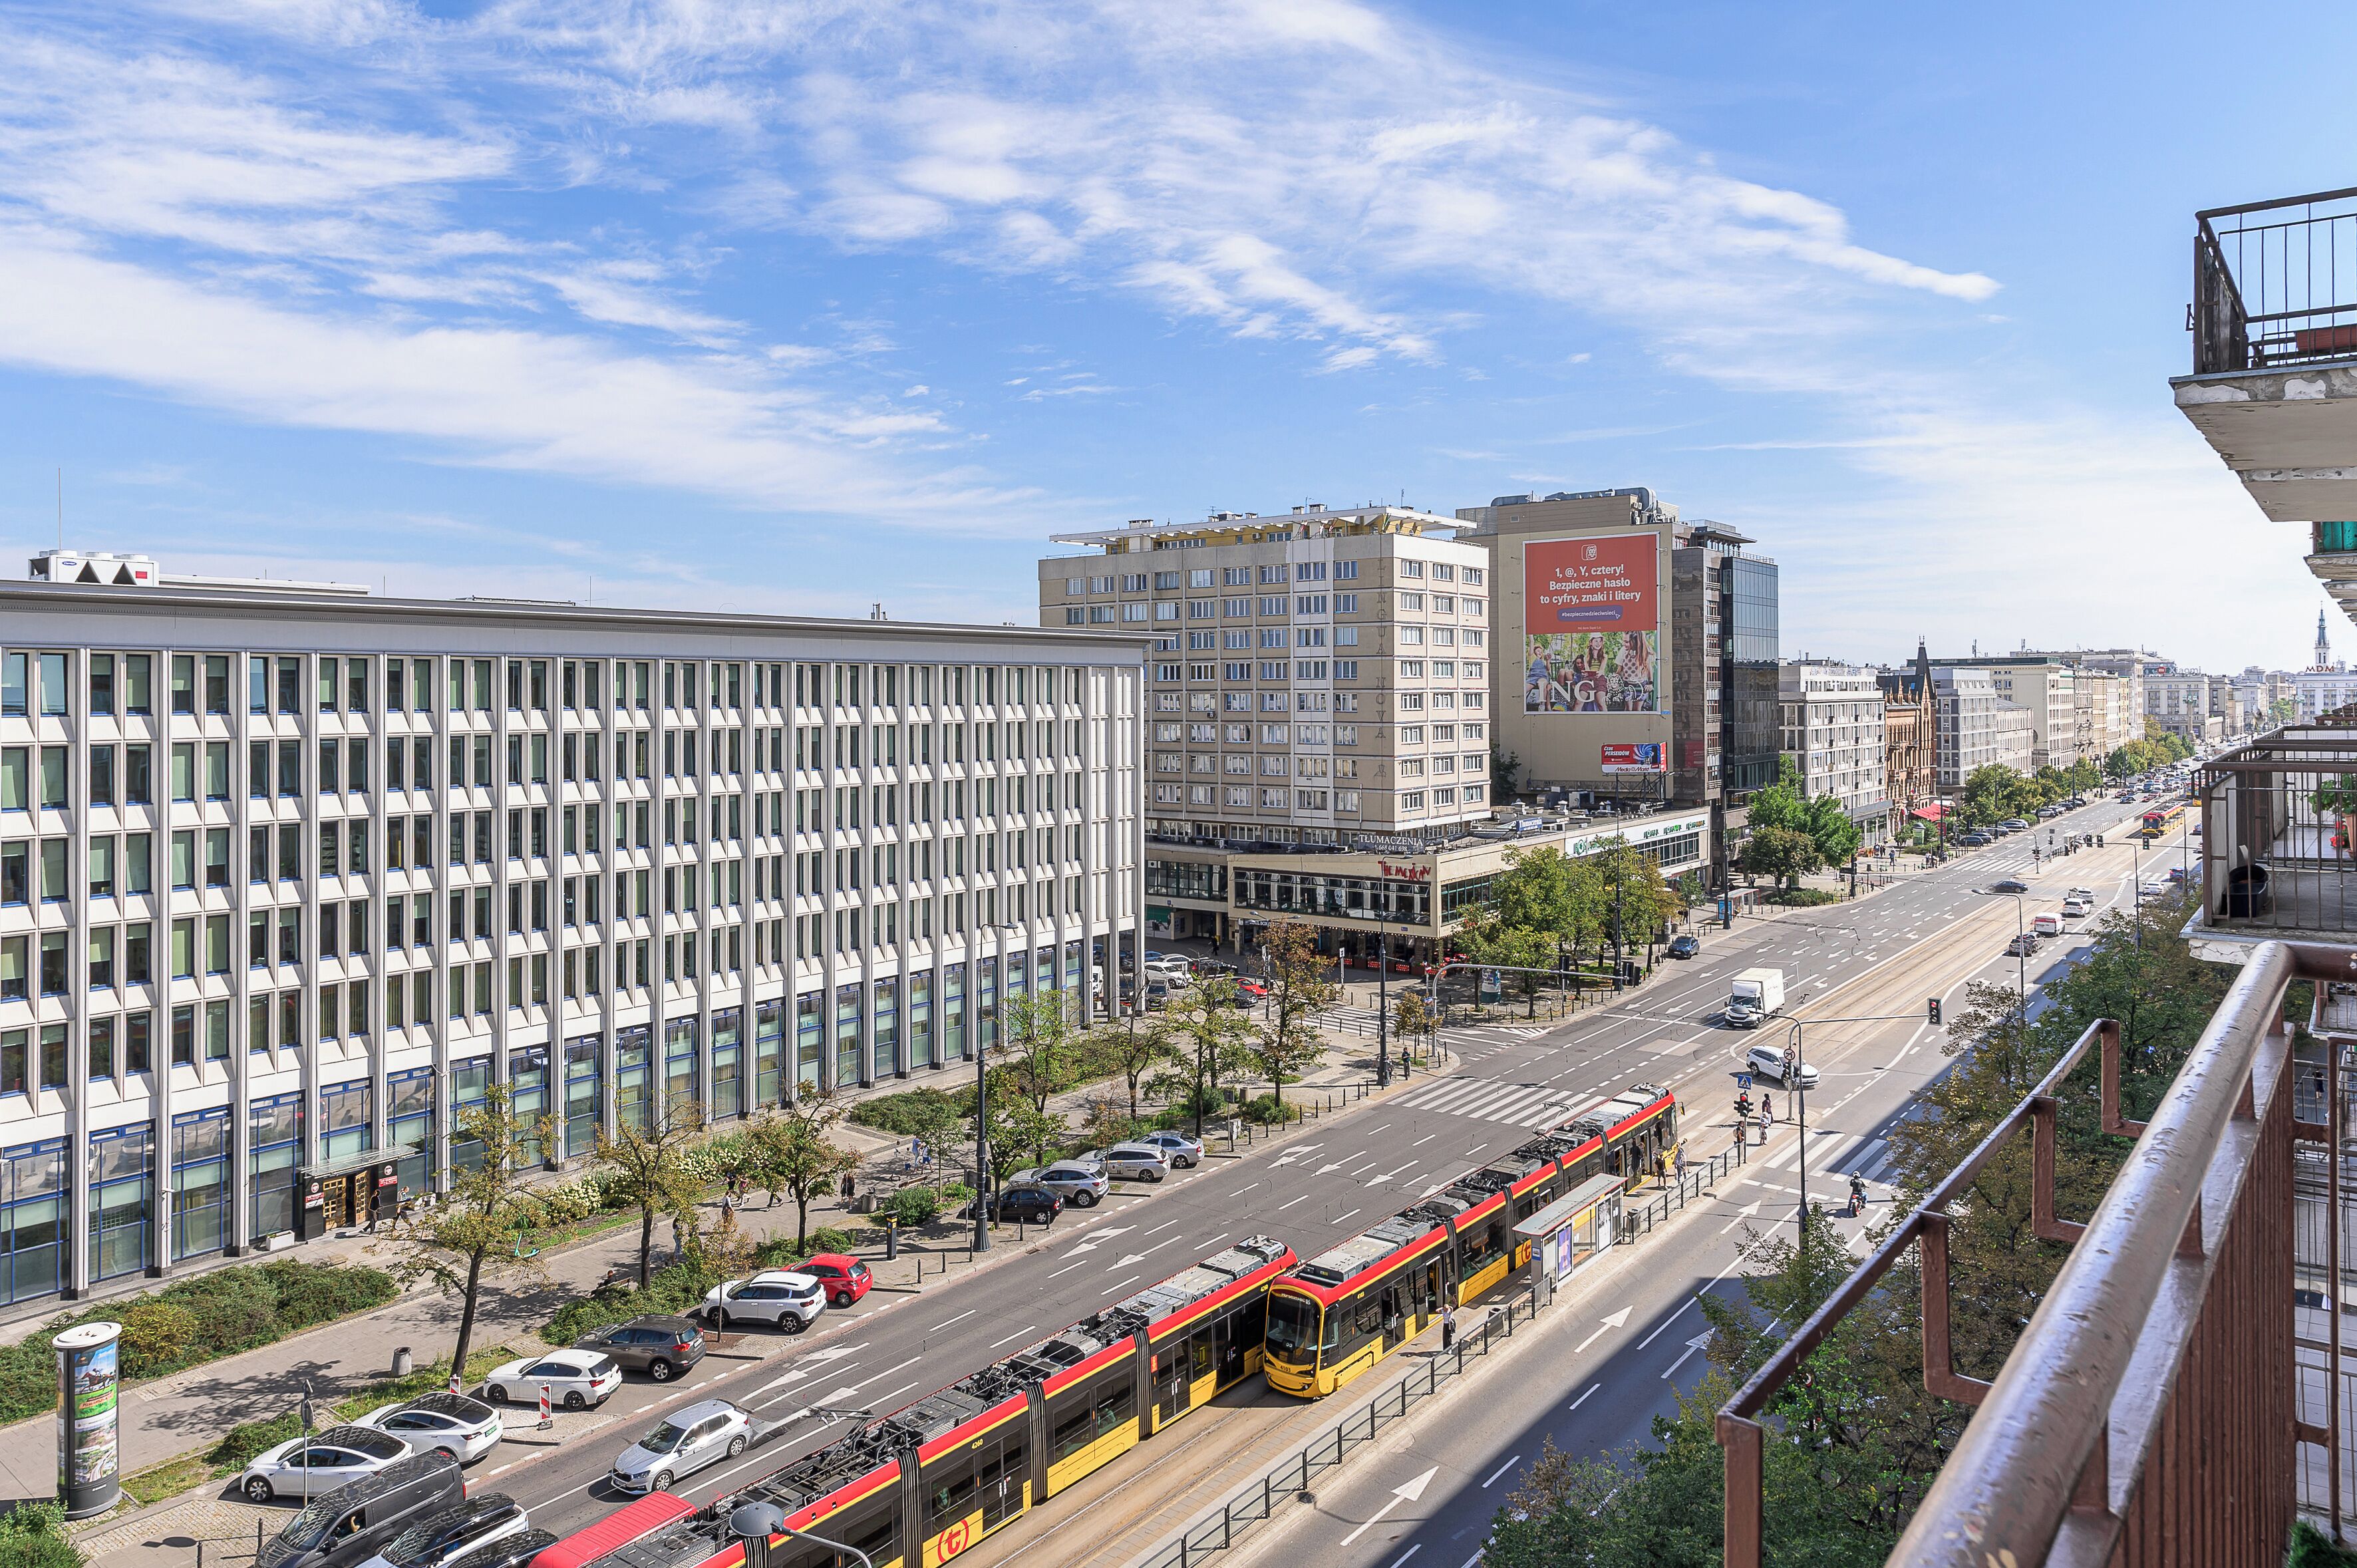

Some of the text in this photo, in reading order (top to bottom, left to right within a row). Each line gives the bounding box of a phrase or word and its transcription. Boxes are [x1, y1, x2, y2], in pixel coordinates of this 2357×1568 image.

[1555, 563, 1624, 578] 1, @, Y, cztery!
[1549, 577, 1631, 592] Bezpieczne hasło
[1539, 595, 1549, 604] to
[1552, 593, 1579, 605] cyfry,
[1581, 591, 1607, 602] znaki
[1615, 590, 1641, 602] litery
[1561, 609, 1615, 618] #bezpiecznedzieciwsieci
[1537, 680, 1597, 703] ING
[1359, 834, 1424, 846] TŁUMACZENIA
[1377, 861, 1394, 877] THE
[971, 1438, 983, 1450] 4260
